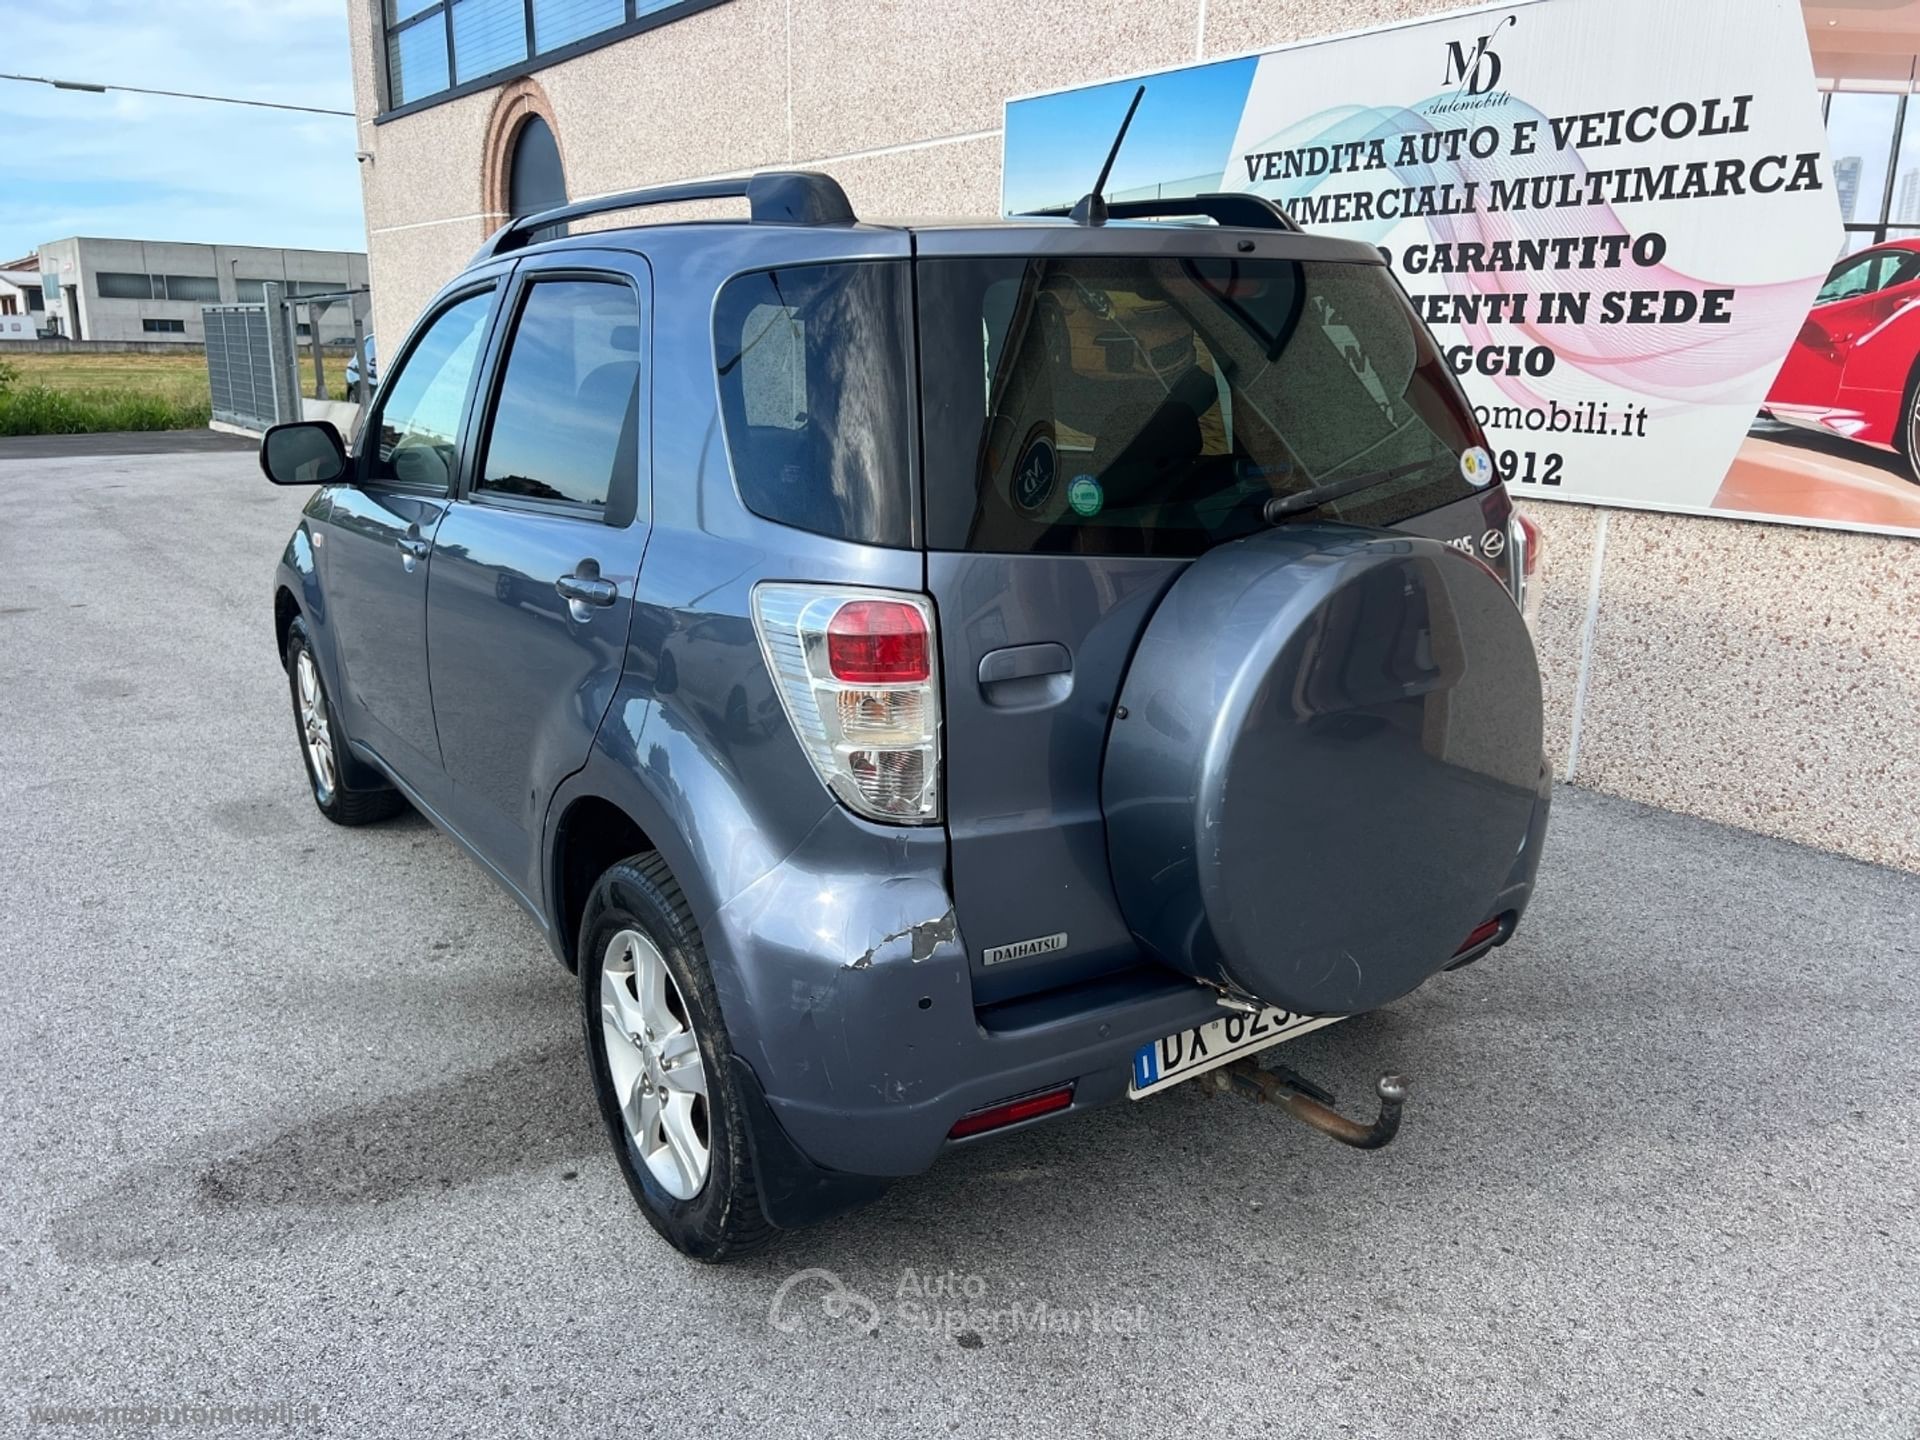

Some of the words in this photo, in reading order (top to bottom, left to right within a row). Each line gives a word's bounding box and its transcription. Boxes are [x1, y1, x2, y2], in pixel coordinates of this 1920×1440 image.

[1244, 139, 1387, 182] VENDITA
[1394, 125, 1500, 168] AUTO
[1510, 120, 1539, 156] E
[1549, 94, 1754, 151] VEICOLI
[1487, 152, 1824, 212] MULTIMARCA
[1402, 232, 1667, 275] GARANTITO
[1536, 292, 1591, 325] IN
[1599, 289, 1736, 325] SEDE
[1442, 345, 1556, 378] GGIO
[1473, 400, 1649, 438] omobili.it
[1493, 448, 1565, 487] 912
[992, 935, 1061, 963] DAIHATSU
